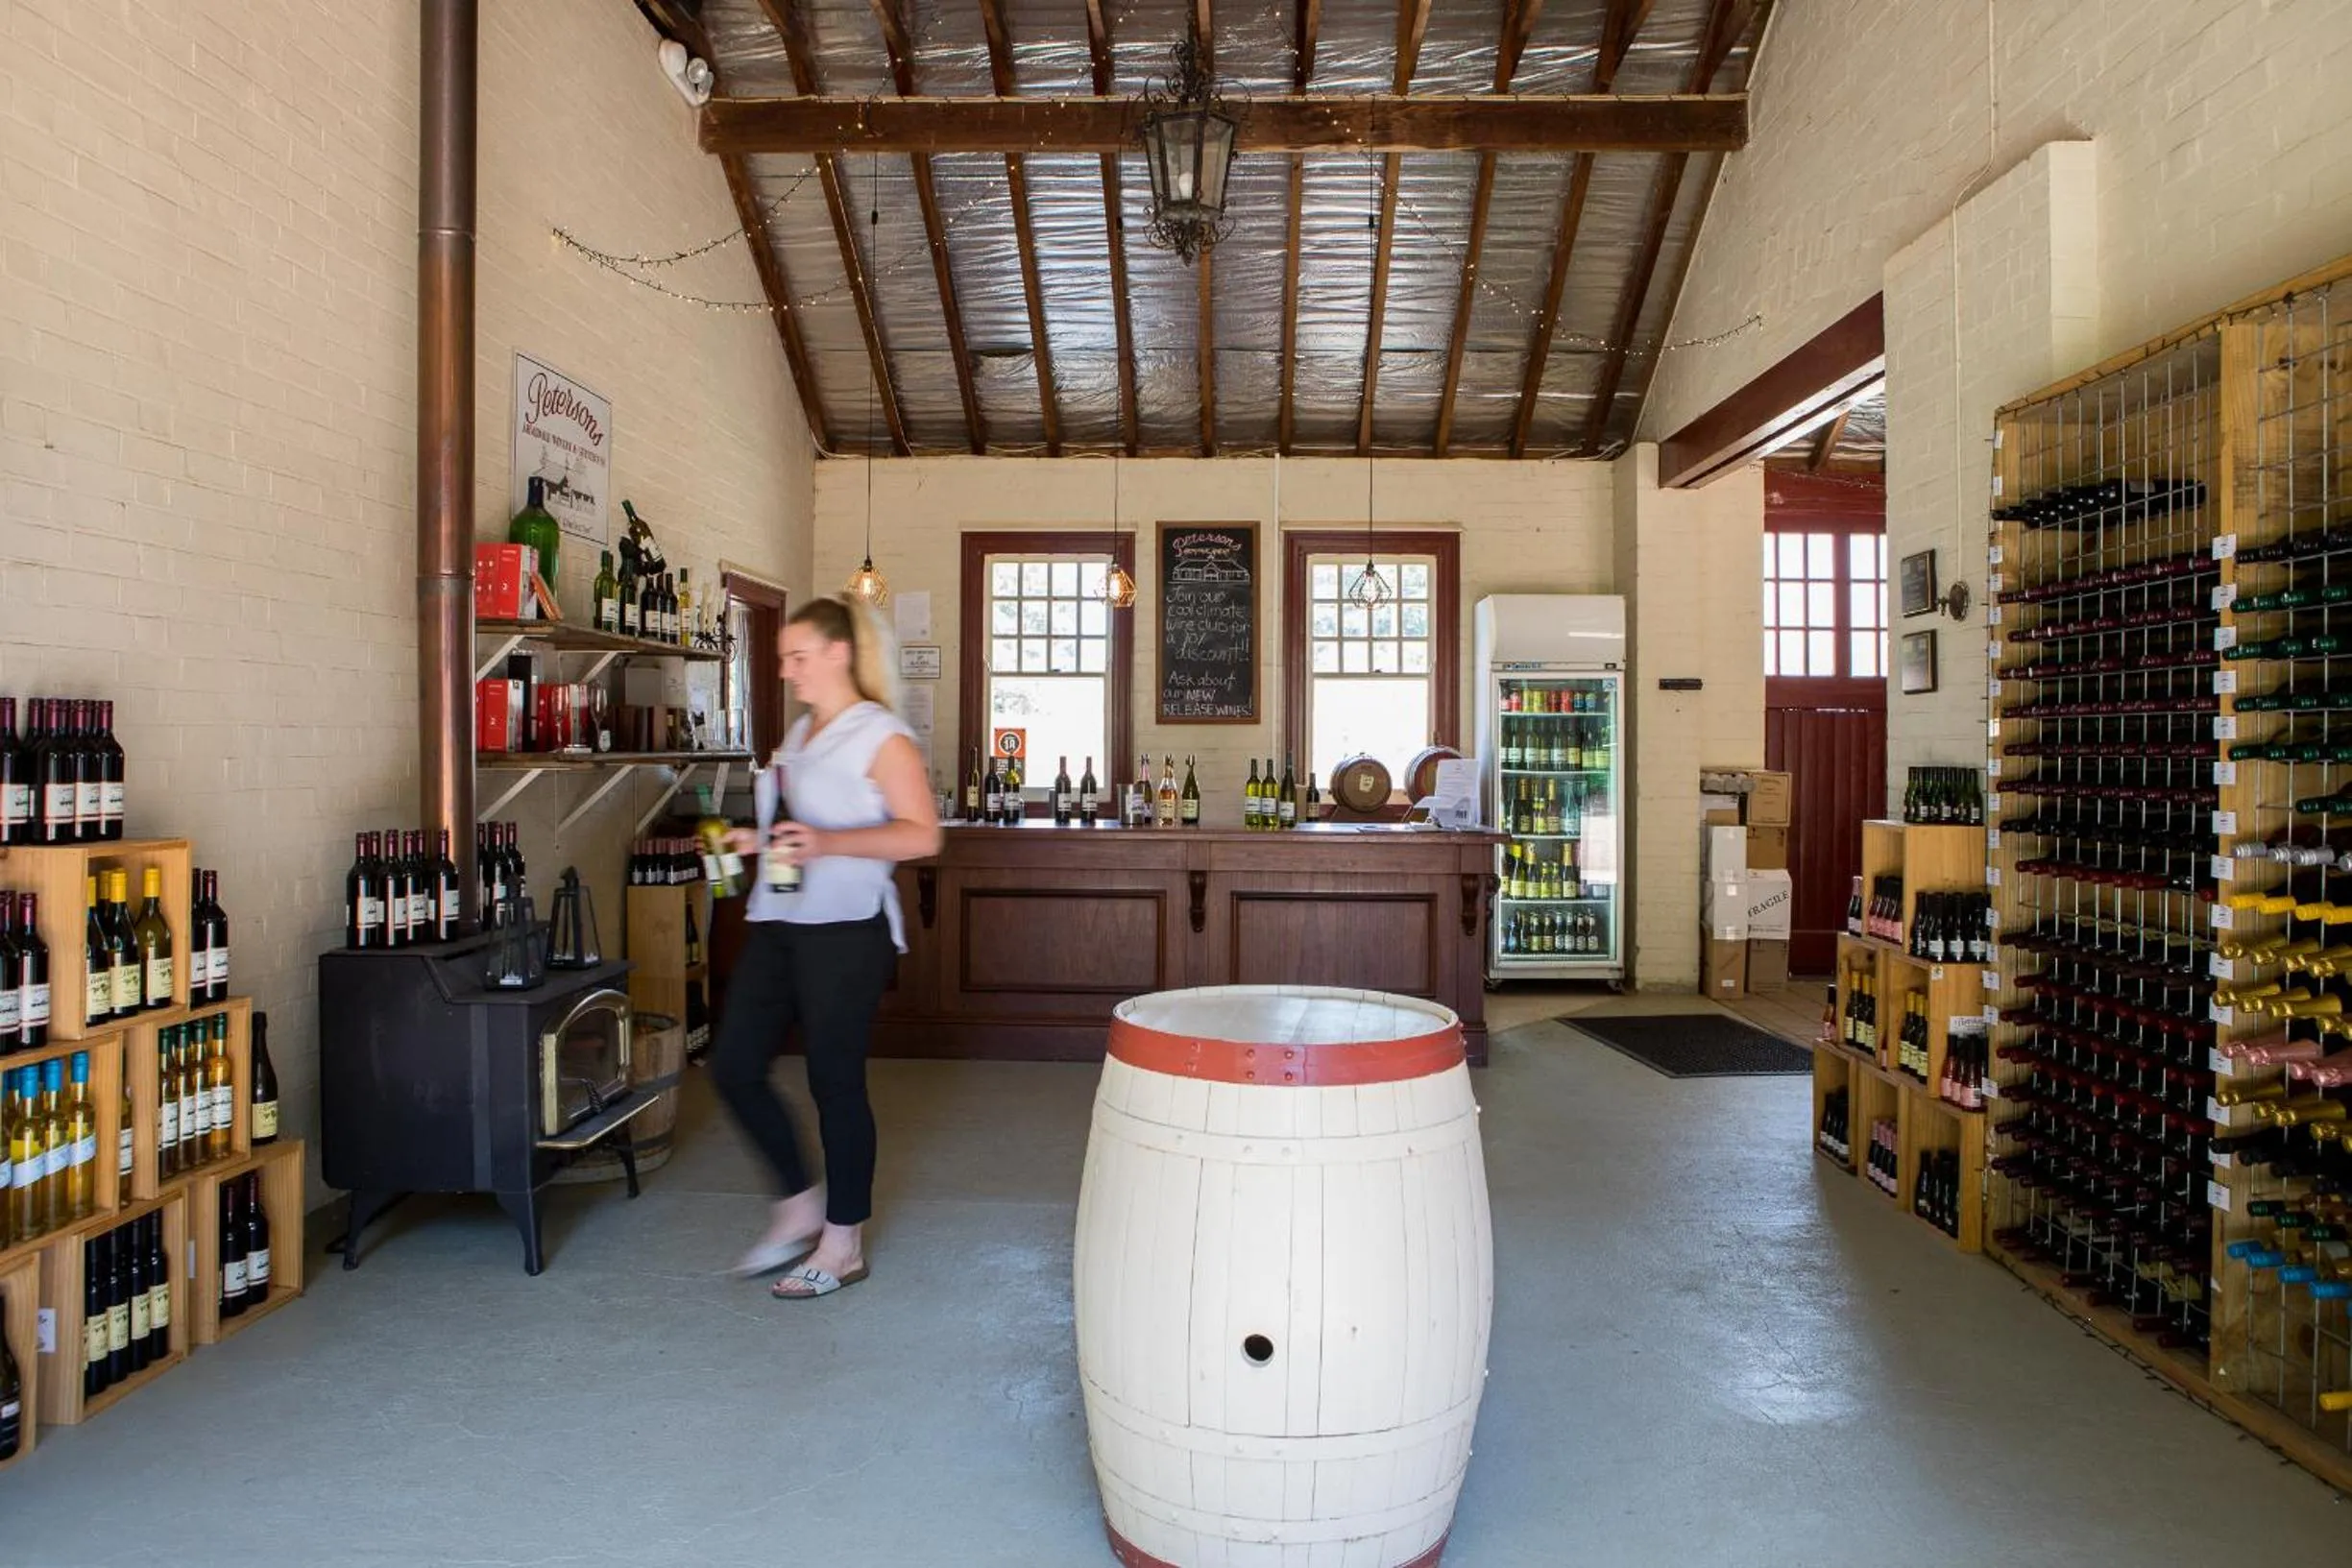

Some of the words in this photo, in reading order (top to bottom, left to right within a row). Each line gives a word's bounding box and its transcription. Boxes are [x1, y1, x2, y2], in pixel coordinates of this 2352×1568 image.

[525, 373, 604, 446] Petersons
[1166, 586, 1196, 603] Join
[1200, 591, 1226, 603] our
[1196, 600, 1246, 618] climate
[1168, 670, 1195, 686] Ask
[1198, 669, 1236, 690] about
[1186, 688, 1216, 702] NEW
[1163, 703, 1214, 716] RELEASE
[1748, 890, 1790, 917] FRAGILE
